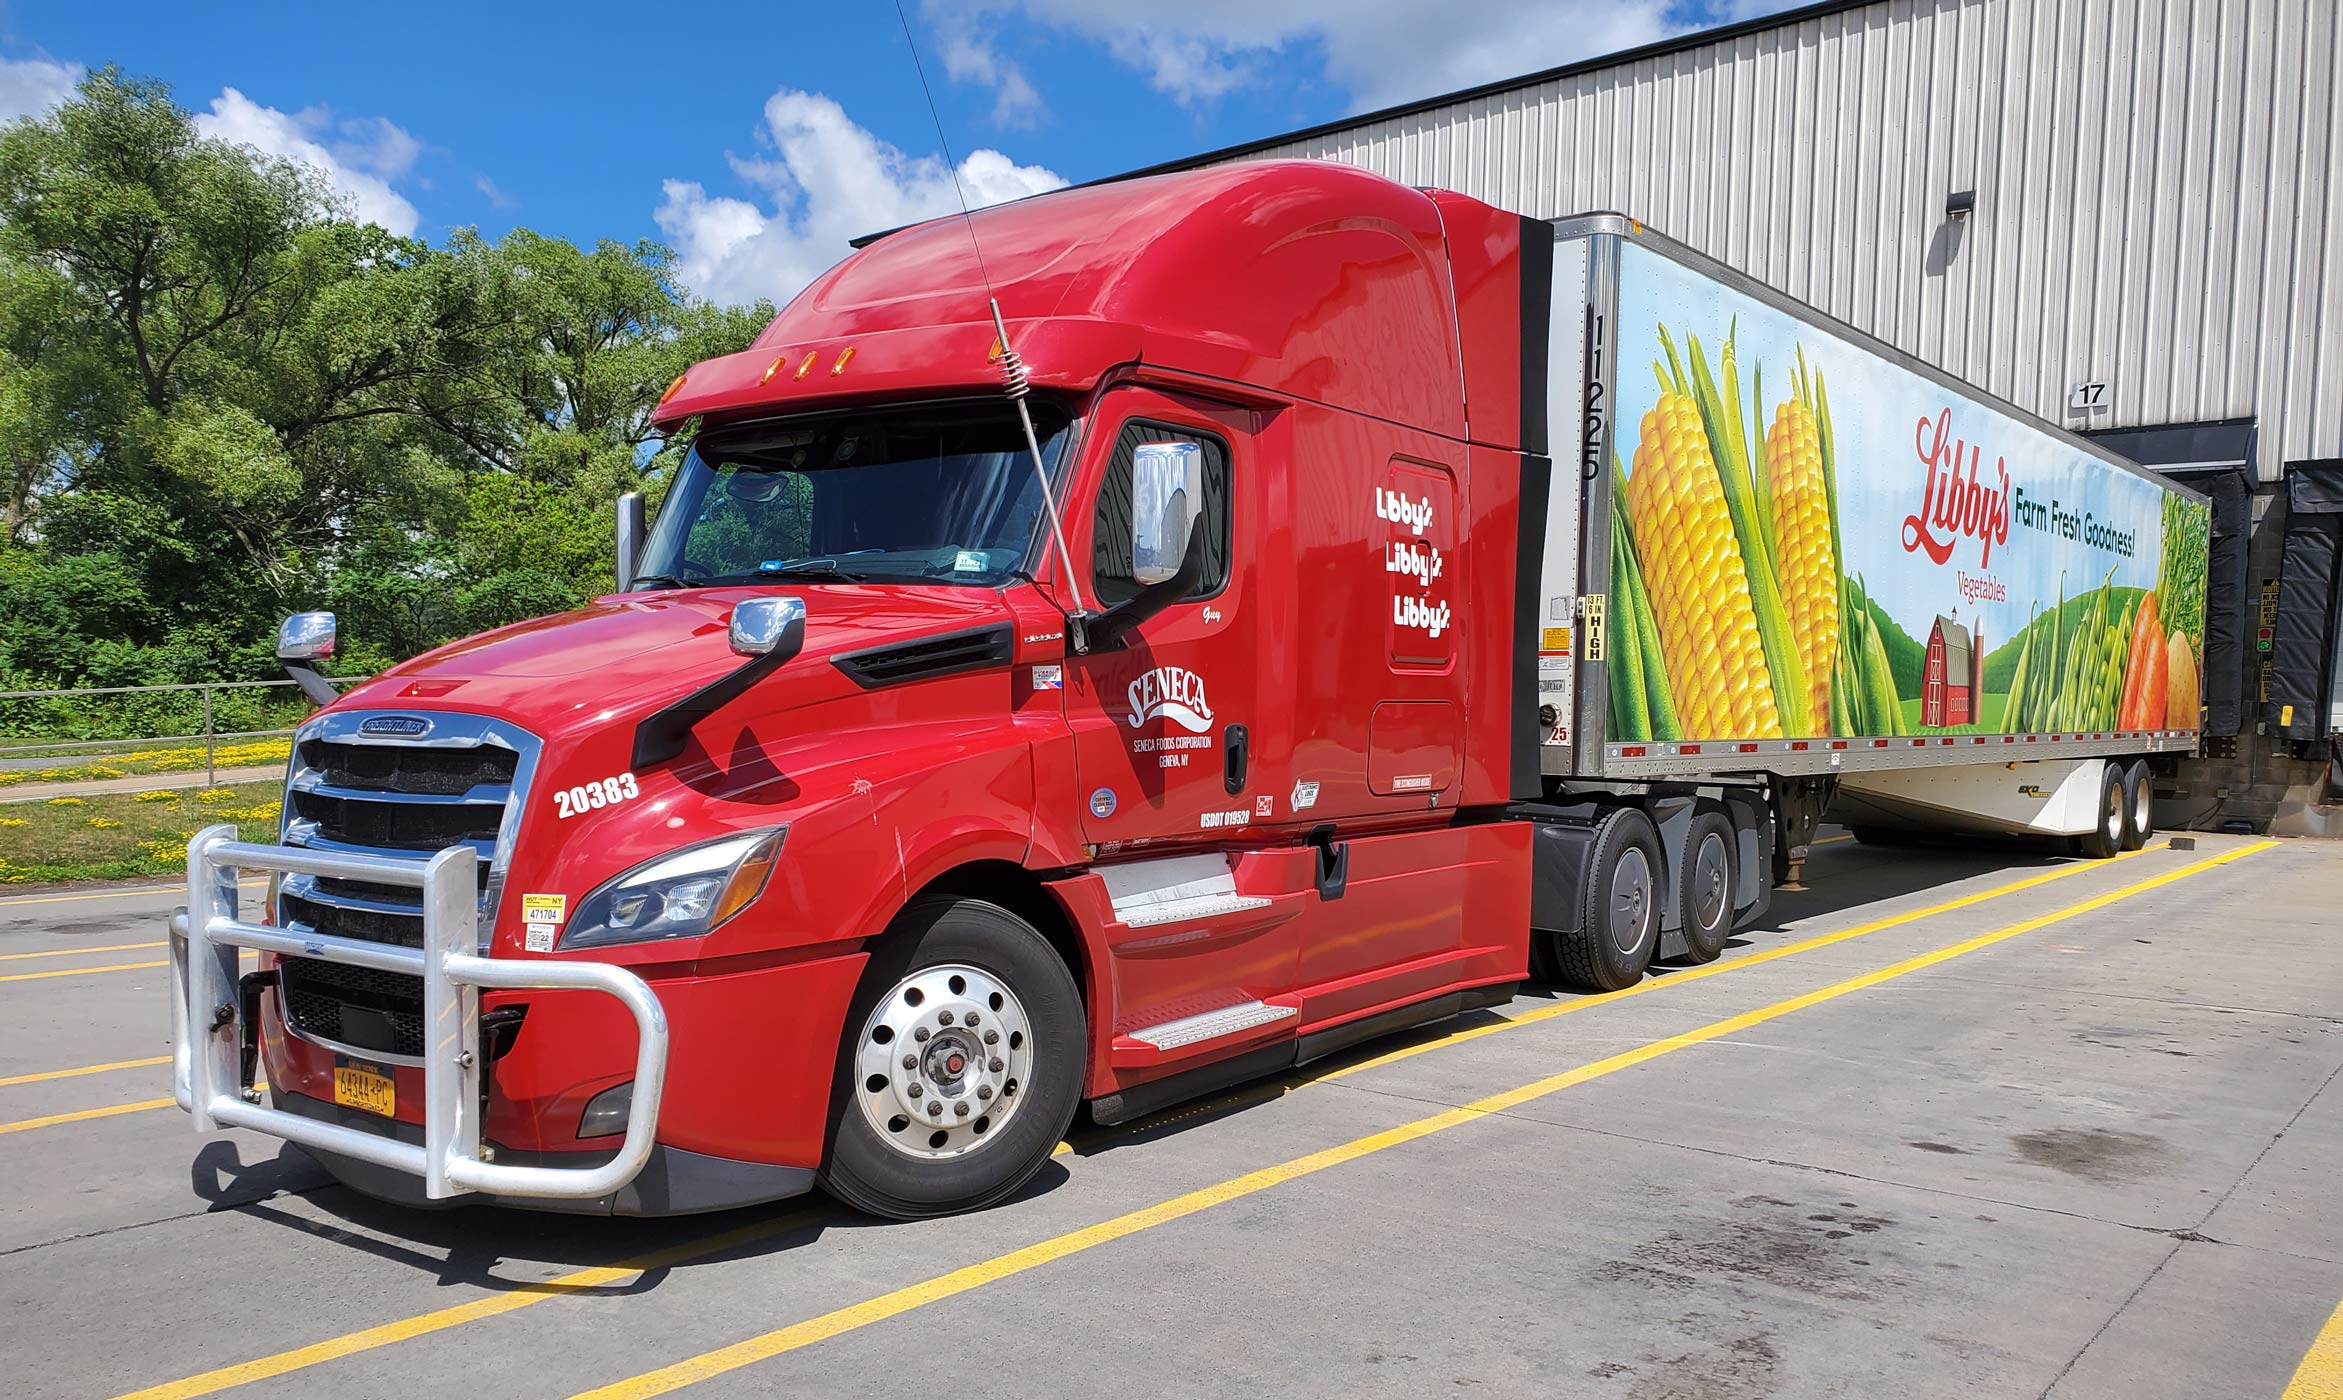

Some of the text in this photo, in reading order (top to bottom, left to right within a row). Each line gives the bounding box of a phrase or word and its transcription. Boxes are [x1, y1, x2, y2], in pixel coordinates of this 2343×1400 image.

[1582, 315, 1604, 481] 11225
[2079, 384, 2105, 404] 17
[1902, 407, 2010, 570] Libby's
[1376, 487, 1433, 535] Libby's
[2015, 487, 2136, 559] Farm Fresh Goodness!
[1386, 541, 1442, 586] Libby's
[1587, 595, 1605, 605] 13 FT.
[1957, 570, 2006, 605] Vegetables
[1202, 606, 1221, 625] Guy
[1394, 595, 1450, 638] Libby's
[1588, 604, 1603, 614] 6 IN.
[1589, 616, 1600, 660] HIGH
[1128, 667, 1211, 728] SENECA
[364, 719, 425, 733] FREIGHTLINER
[1133, 736, 1211, 753] SENECA FOODS CORPORATION
[1159, 754, 1189, 768] GENEVA, NY
[553, 772, 639, 819] 20383
[1200, 810, 1250, 828] USDOT 019528
[530, 909, 557, 920] 471704
[540, 934, 550, 942] 22
